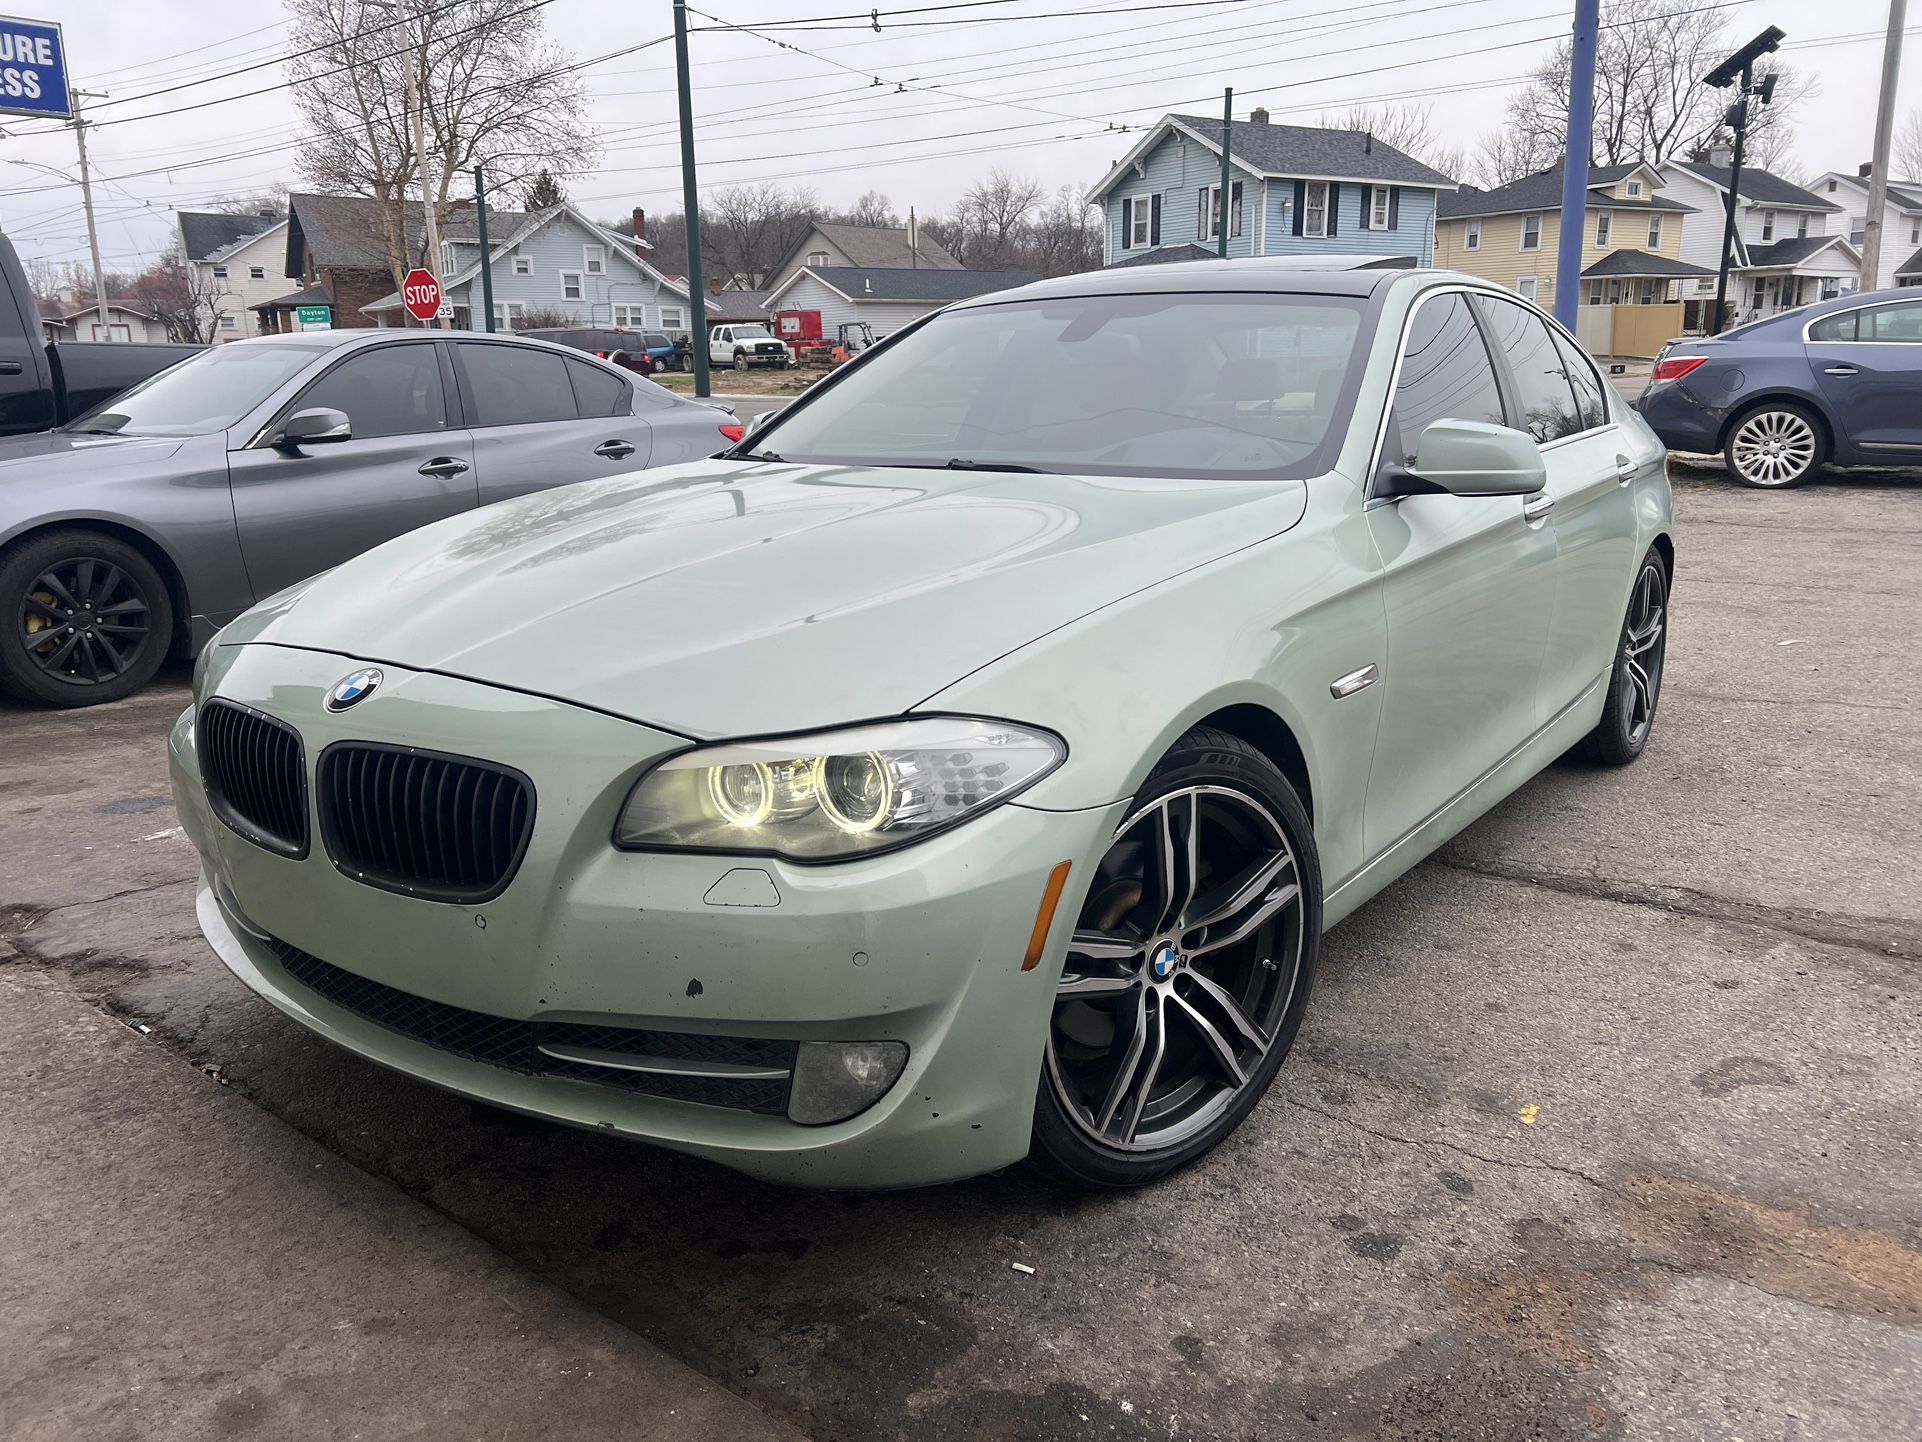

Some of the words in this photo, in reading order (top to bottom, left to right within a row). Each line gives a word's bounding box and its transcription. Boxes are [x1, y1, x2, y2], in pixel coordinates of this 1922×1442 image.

[0, 67, 41, 99] SS
[406, 284, 438, 305] STOP
[439, 307, 452, 316] 35
[1168, 942, 1180, 978] BMW
